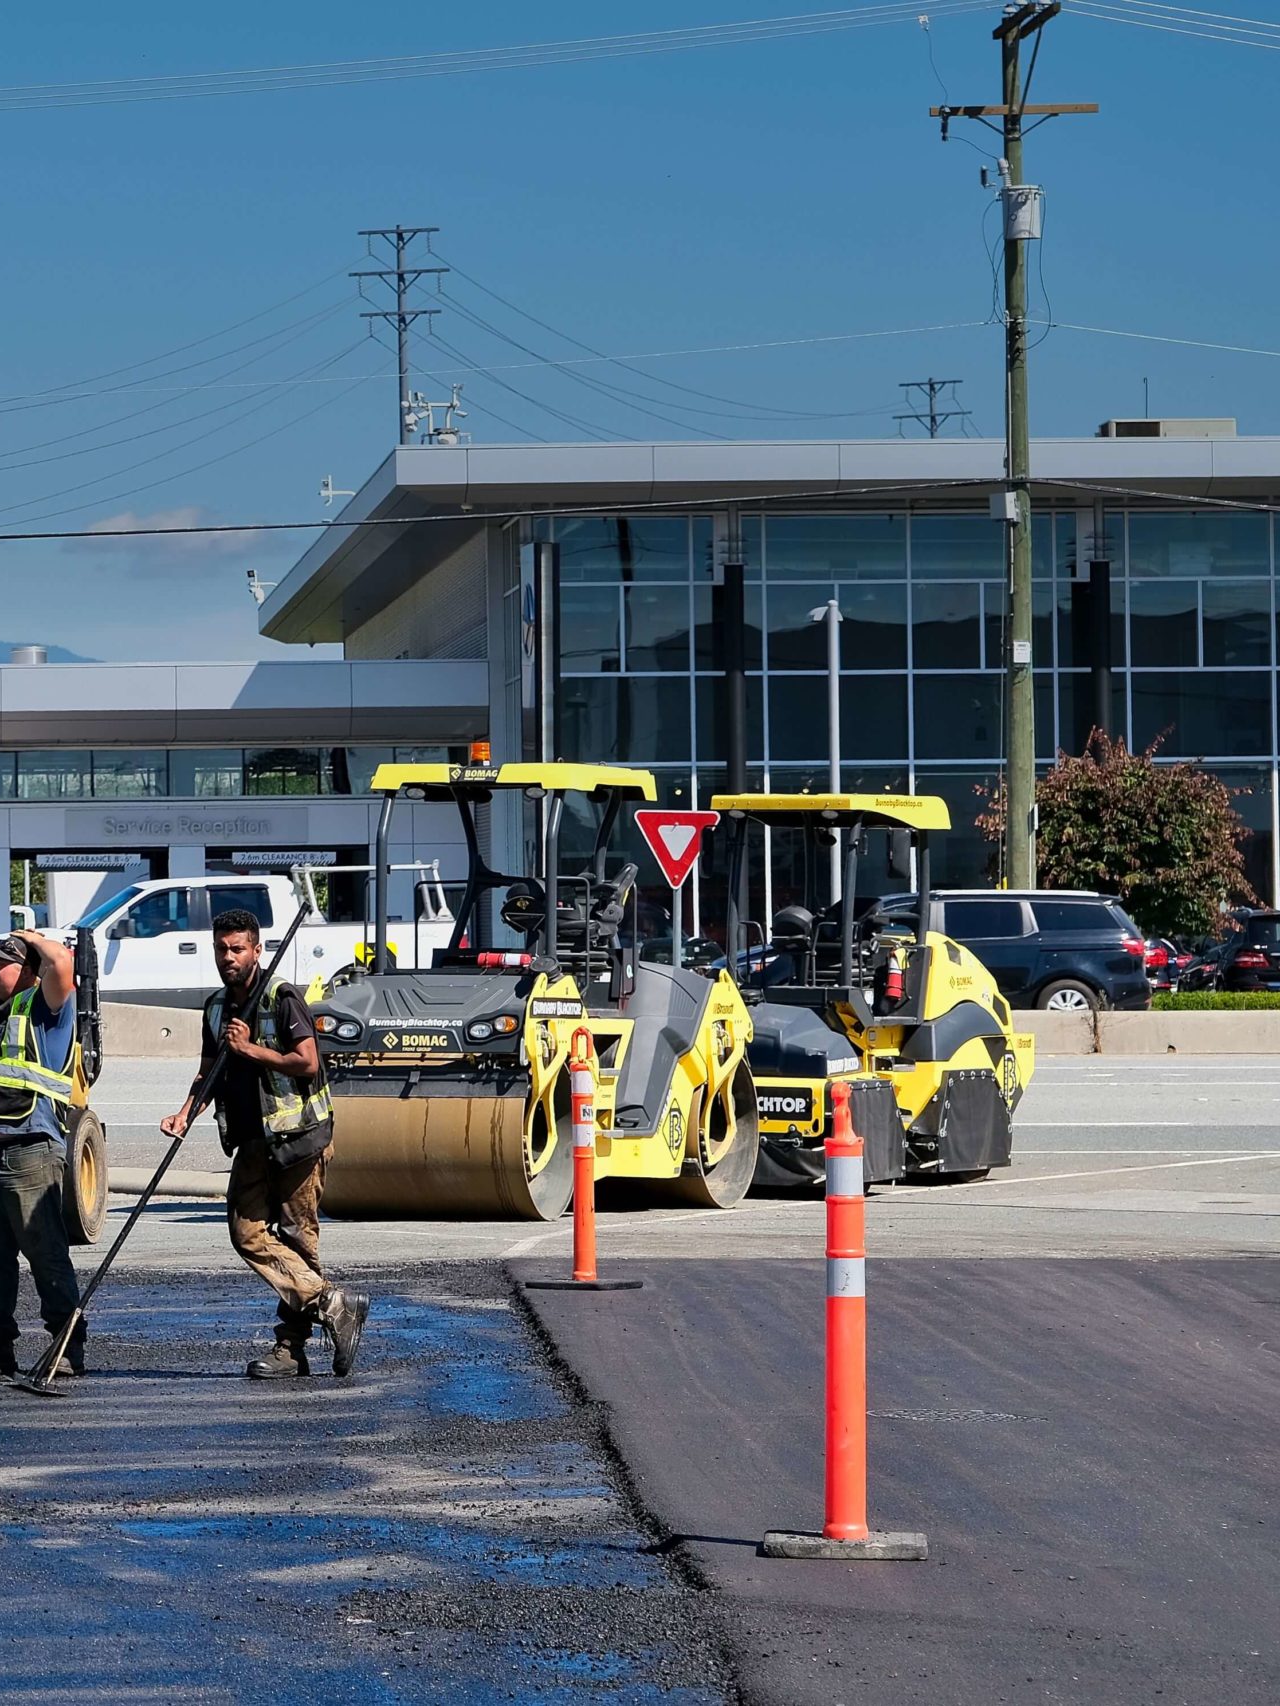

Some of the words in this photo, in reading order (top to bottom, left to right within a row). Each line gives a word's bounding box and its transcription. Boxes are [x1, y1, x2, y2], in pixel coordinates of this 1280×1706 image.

[464, 769, 498, 777] BOMAG
[103, 815, 171, 835] Service
[177, 815, 272, 838] Reception
[65, 855, 111, 863] CLEARANCE
[261, 853, 307, 861] CLEARANCE
[368, 1018, 463, 1029] BurnabyBlacktop.ca
[401, 1035, 448, 1047] BOMAG
